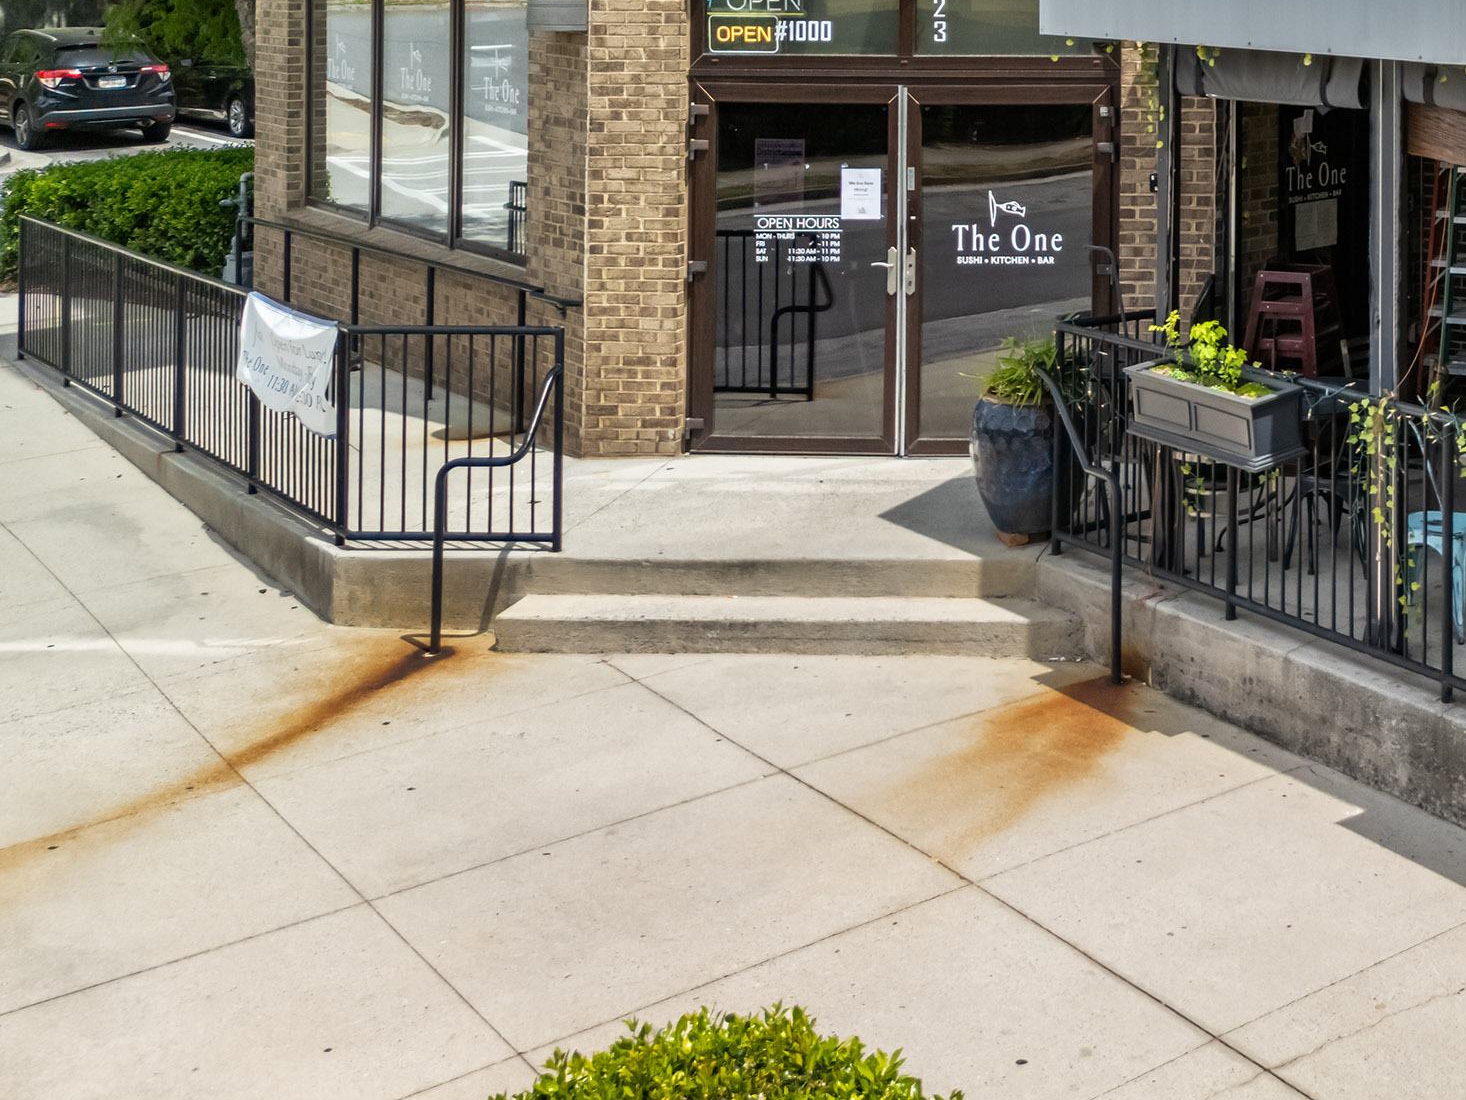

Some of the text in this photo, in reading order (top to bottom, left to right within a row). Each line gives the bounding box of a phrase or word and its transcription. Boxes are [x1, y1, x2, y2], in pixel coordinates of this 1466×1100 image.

[716, 20, 832, 42] OPEN #1000
[400, 67, 432, 92] The One
[483, 77, 520, 104] The One
[1285, 161, 1347, 192] The One
[757, 217, 840, 229] OPEN HOURS
[951, 223, 1063, 252] The One
[956, 256, 1055, 264] SUSHI KITCHEN BAR
[253, 356, 270, 375] One
[267, 374, 289, 394] 11:30
